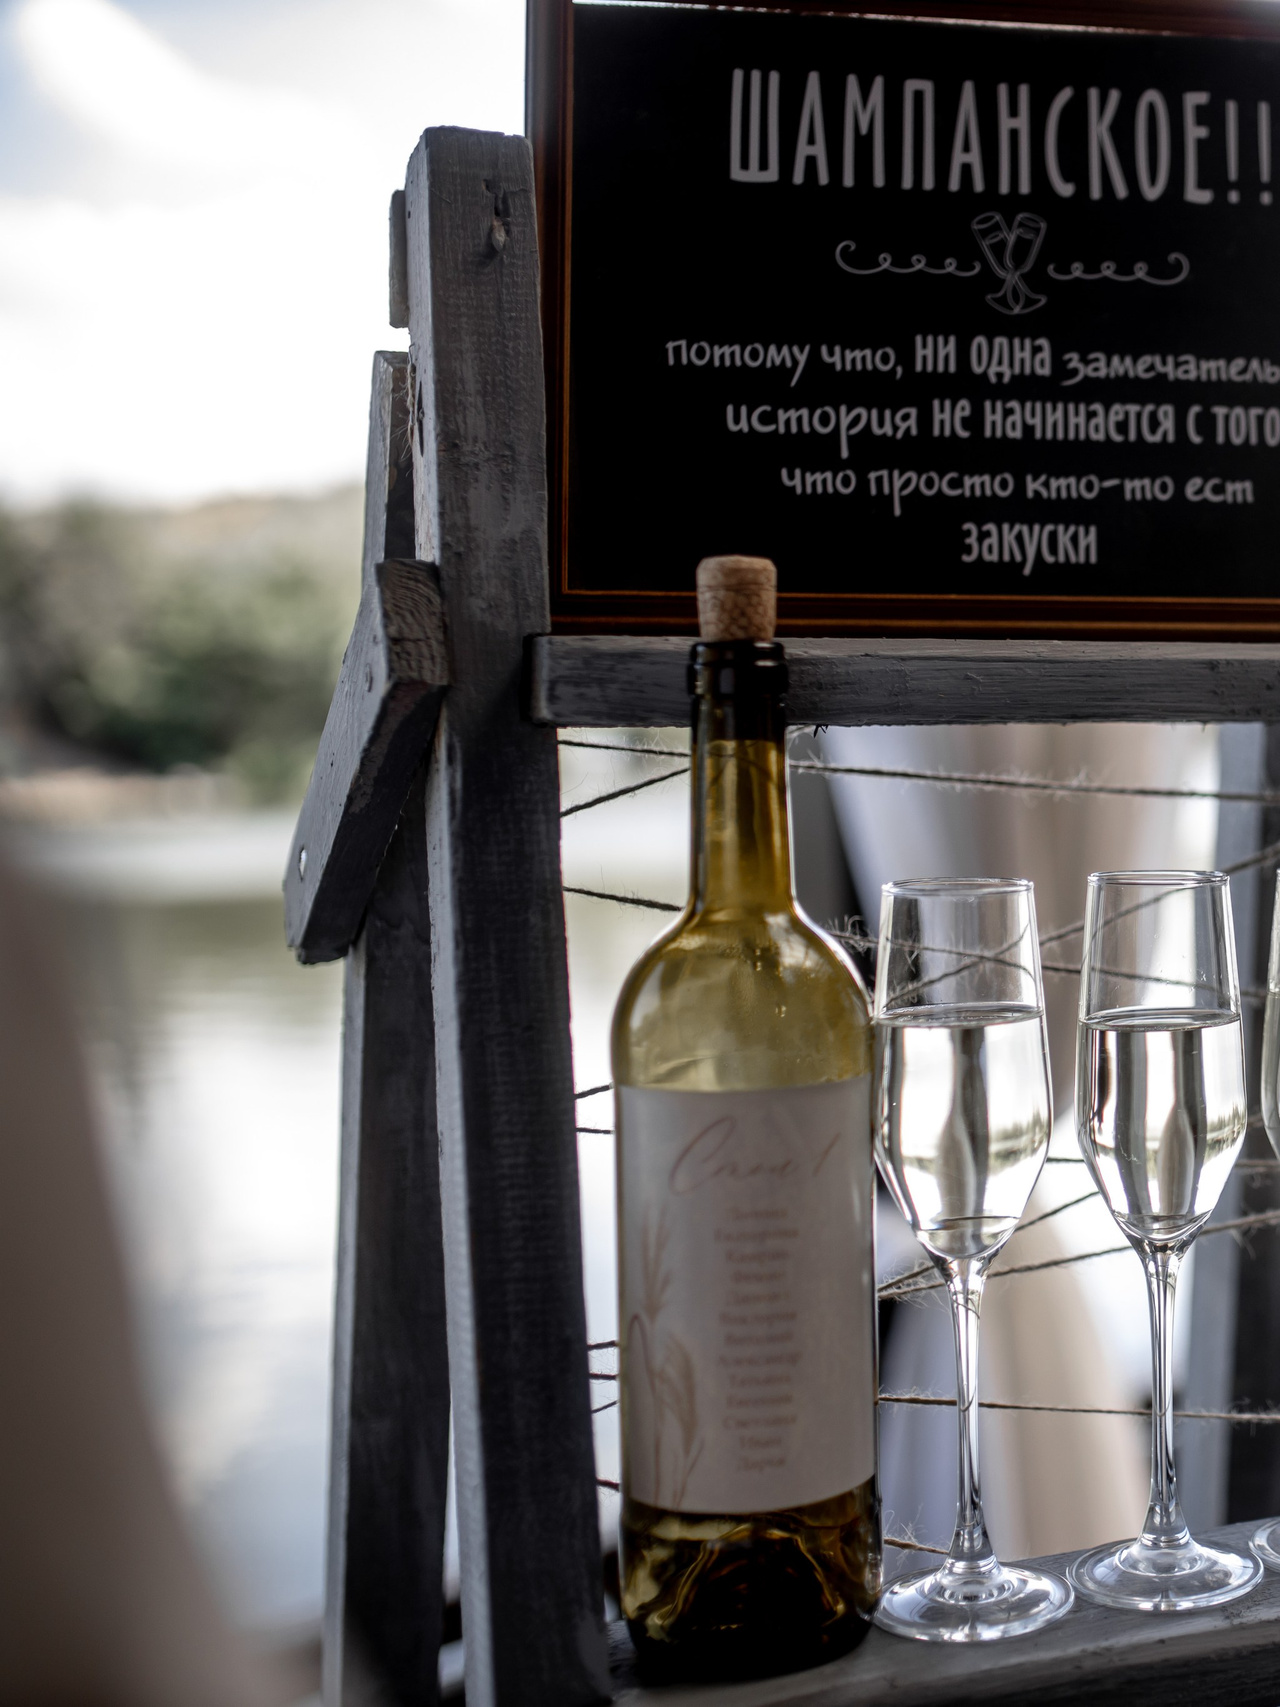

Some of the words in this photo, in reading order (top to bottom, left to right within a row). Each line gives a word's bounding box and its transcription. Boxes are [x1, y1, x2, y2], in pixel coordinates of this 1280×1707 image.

[665, 339, 810, 387] потому
[820, 344, 903, 379] что,
[915, 334, 957, 374] ни
[970, 335, 1052, 384] одна
[726, 403, 918, 459] история
[932, 398, 971, 439] не
[984, 399, 1175, 443] начинается
[1186, 404, 1203, 445] с
[780, 467, 857, 496] что
[867, 469, 1014, 517] просто
[1025, 474, 1175, 501] кто-то
[1184, 475, 1254, 504] ест
[961, 522, 1098, 576] закуски
